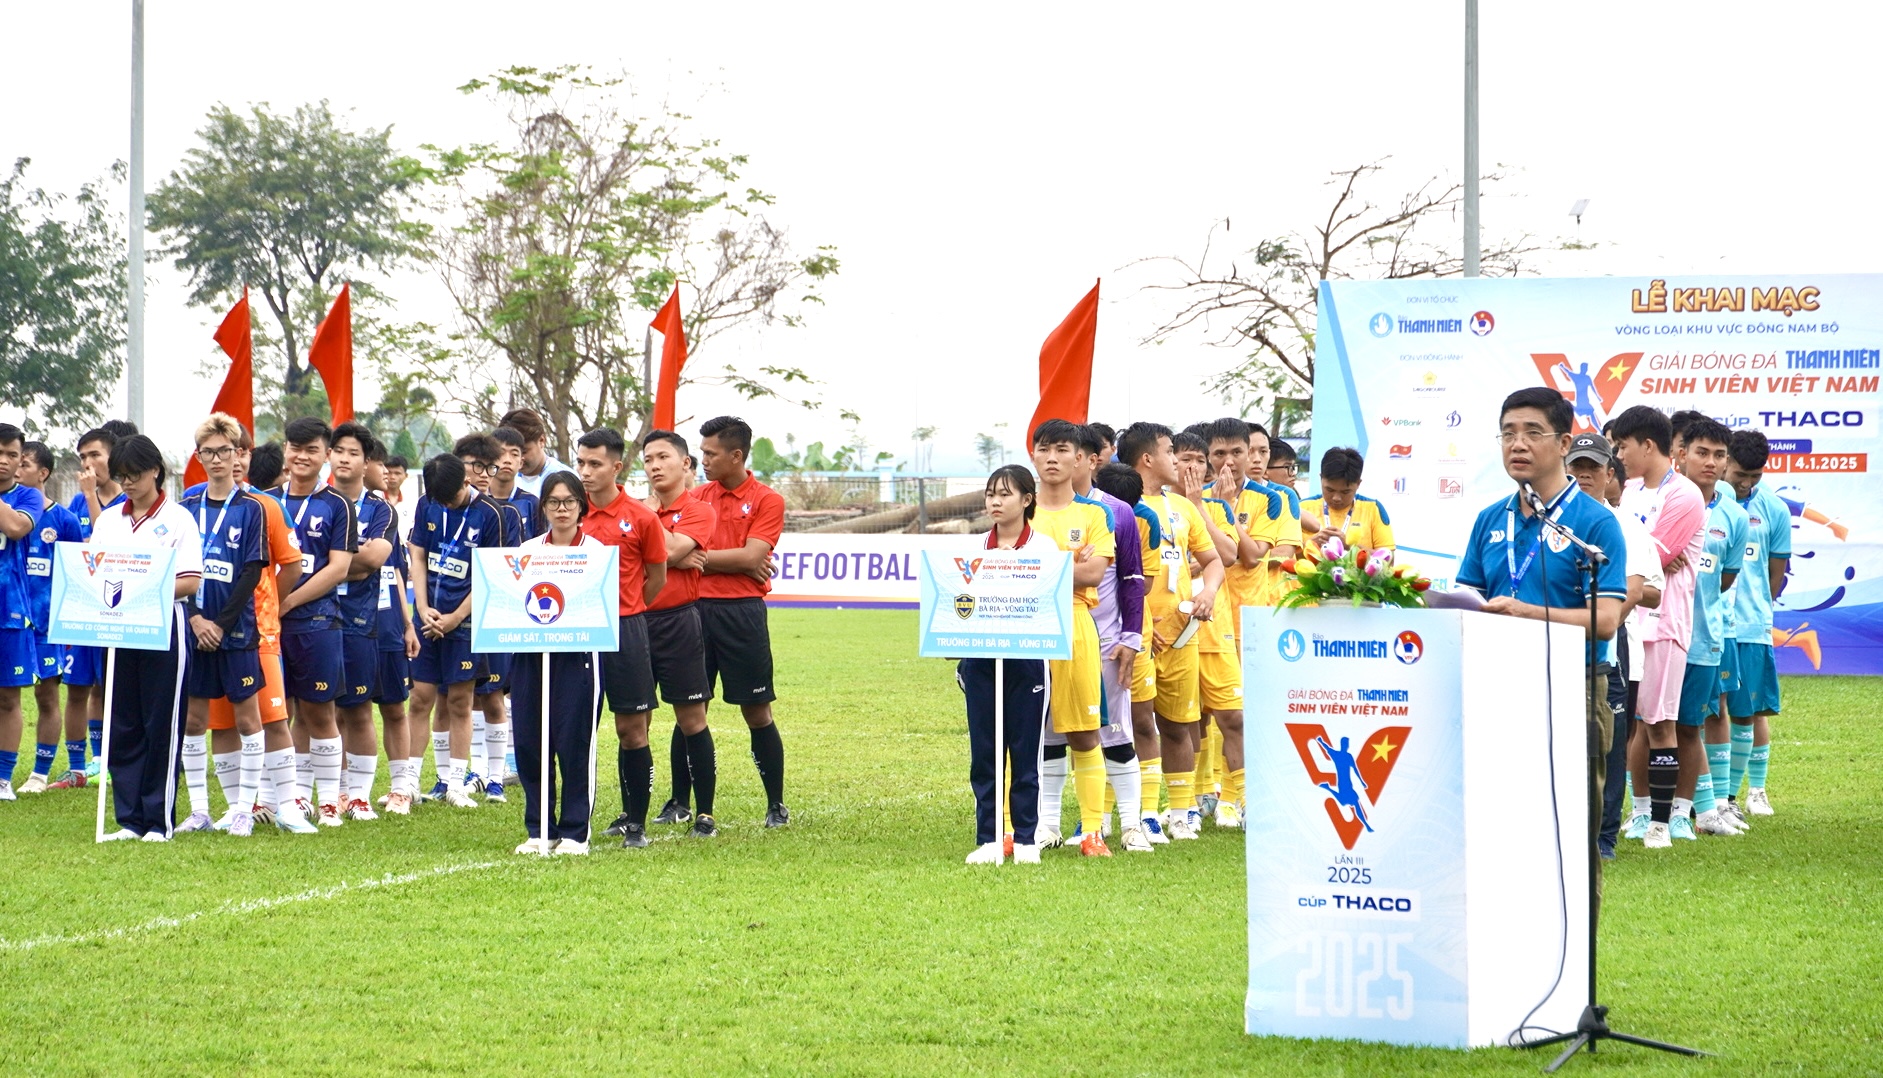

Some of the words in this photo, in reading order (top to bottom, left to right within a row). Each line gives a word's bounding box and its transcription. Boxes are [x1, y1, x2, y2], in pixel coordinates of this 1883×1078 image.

[1631, 279, 1667, 313] LỄ
[1673, 287, 1745, 312] KHAI
[1752, 286, 1821, 317] MẠC
[1398, 320, 1435, 333] THANH
[1437, 318, 1462, 332] NIÊN
[1615, 324, 1651, 335] VÒNG
[1654, 325, 1683, 336] LOẠI
[1687, 325, 1712, 334] KHU
[1717, 323, 1742, 336] VỰC
[1747, 321, 1784, 334] ĐÔNG
[1788, 323, 1816, 333] NAM
[1821, 321, 1839, 335] BỘ
[1650, 351, 1686, 370] GIẢI
[1691, 351, 1746, 370] BÓNG
[1751, 351, 1777, 369] ĐÁ
[1786, 350, 1840, 369] THANH
[1843, 348, 1880, 368] NIÊN
[1640, 377, 1697, 394] SINH
[1704, 374, 1759, 393] VIÊN
[1767, 373, 1820, 396] VIỆT
[1825, 376, 1880, 393] NAM
[1758, 411, 1863, 427] THACO
[1795, 457, 1857, 470] 4.1.2025
[979, 604, 987, 612] BÀ
[498, 632, 521, 643] GIÁM
[544, 633, 573, 644] TRỌNG
[576, 631, 589, 642] TÀI
[985, 637, 997, 648] BÀ
[1042, 639, 1057, 649] TÀU
[1313, 640, 1356, 657] THANH
[1358, 640, 1387, 658] NIÊN
[1288, 688, 1307, 700] GIẢI
[1308, 688, 1338, 701] BÓNG
[1339, 689, 1354, 701] ĐÁ
[1357, 689, 1387, 701] THANH
[1388, 689, 1409, 702] NIÊN
[1288, 703, 1315, 714] SINH
[1320, 703, 1348, 715] VIÊN
[1352, 703, 1378, 718] VIỆT
[1382, 706, 1408, 716] NAM
[1356, 856, 1364, 865] III
[1328, 867, 1372, 885] 2025
[1298, 895, 1327, 908] CÚP
[1333, 895, 1412, 913] THACO
[1296, 932, 1414, 1020] 2025
